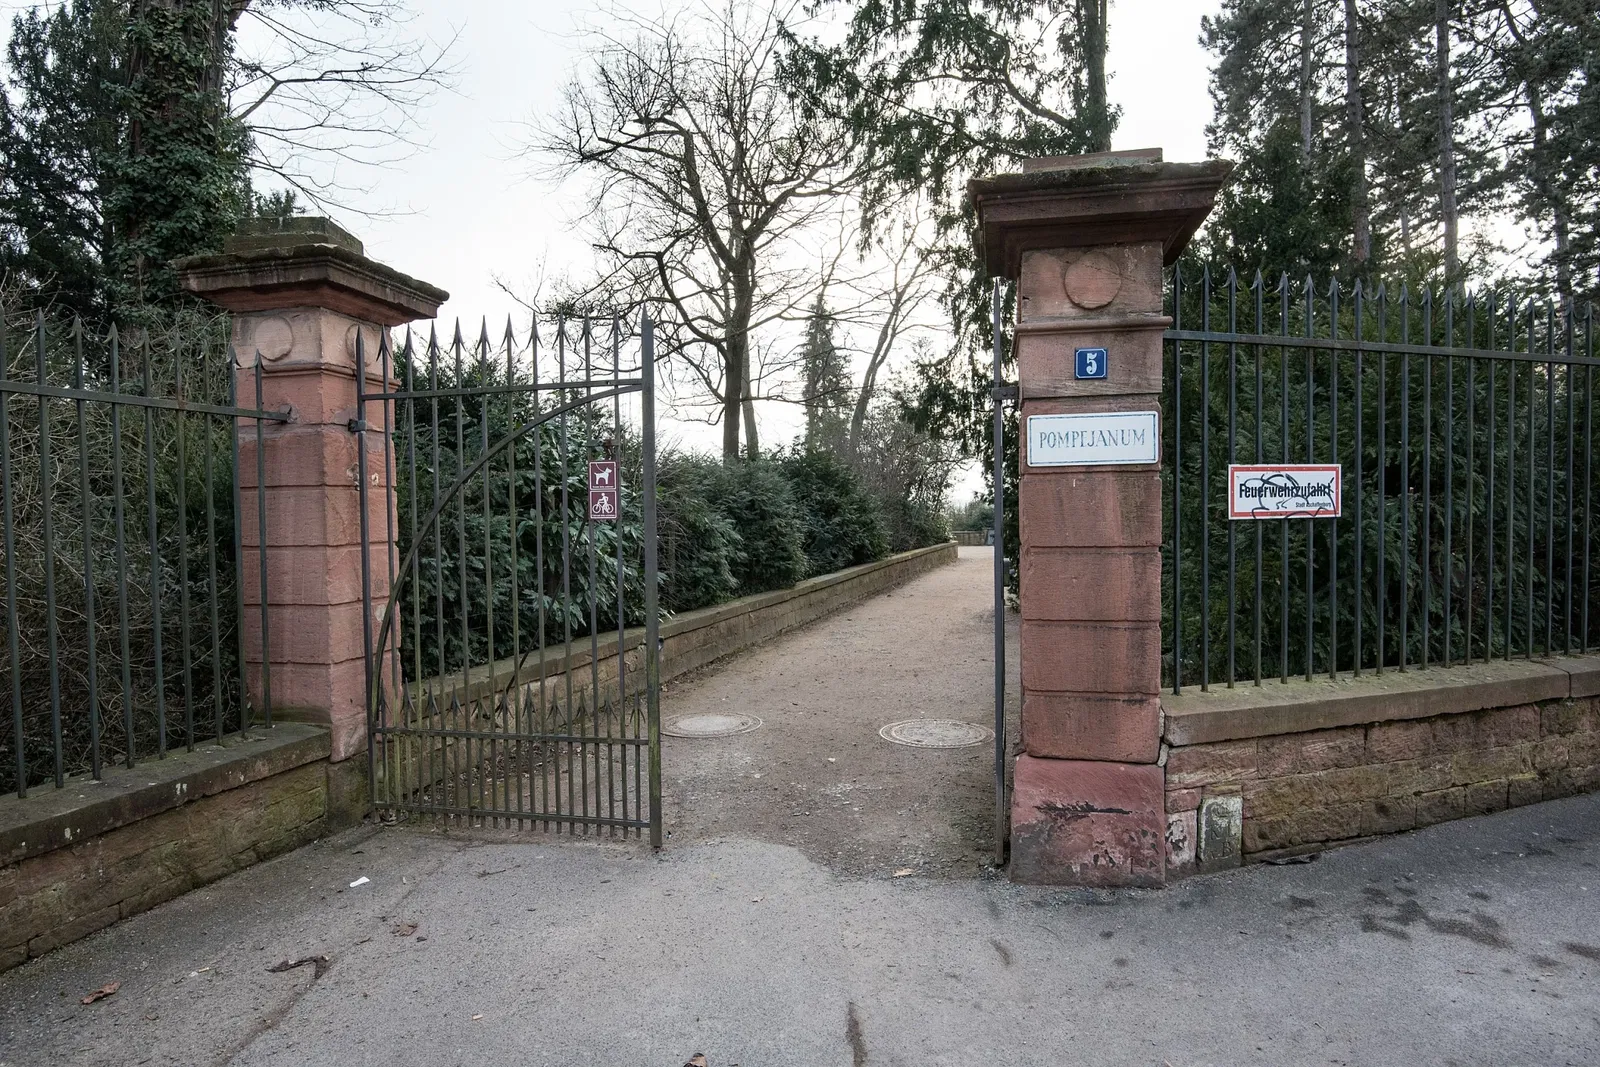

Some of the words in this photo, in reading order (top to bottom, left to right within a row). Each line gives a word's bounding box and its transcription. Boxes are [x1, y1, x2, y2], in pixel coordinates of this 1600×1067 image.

[1086, 352, 1098, 375] 5
[1039, 429, 1145, 449] POMPEJANUM
[1239, 482, 1331, 498] Feuerwehrzufahrt
